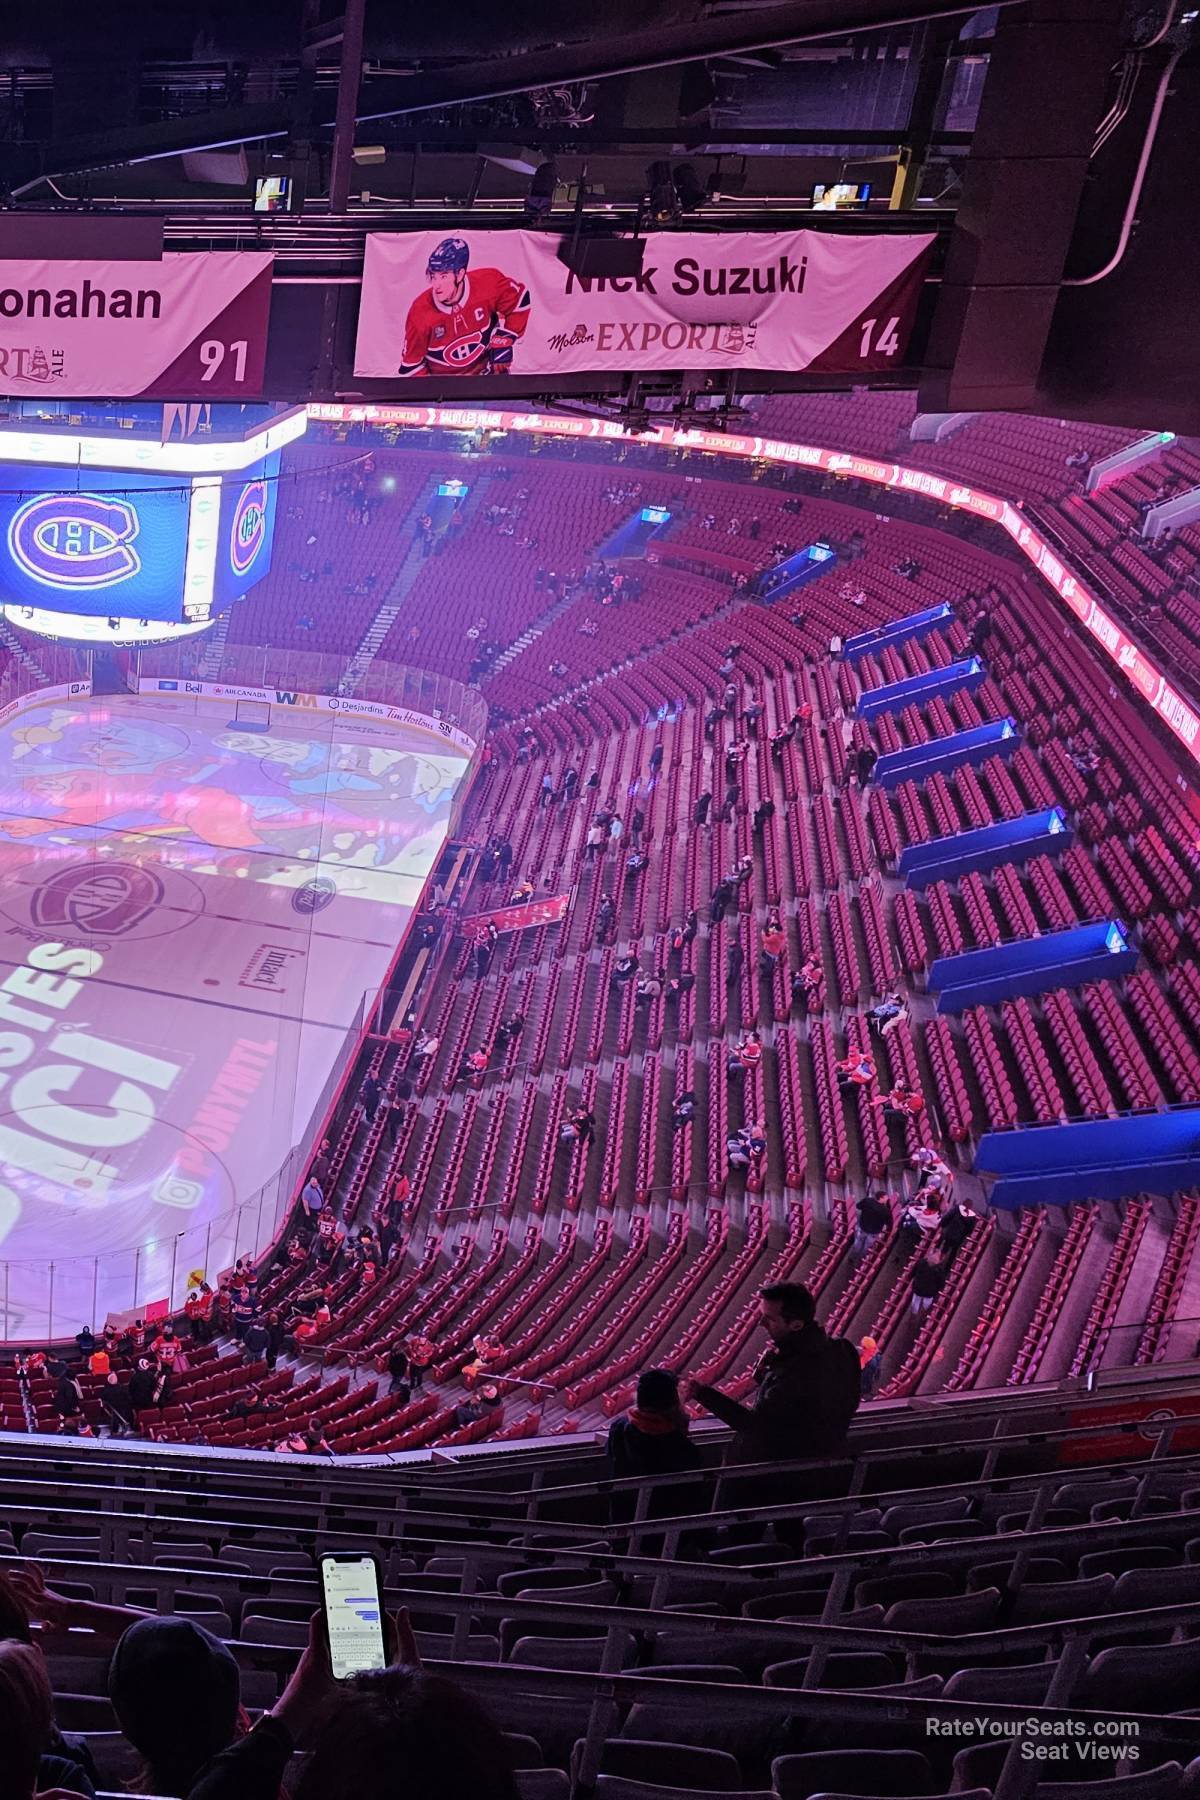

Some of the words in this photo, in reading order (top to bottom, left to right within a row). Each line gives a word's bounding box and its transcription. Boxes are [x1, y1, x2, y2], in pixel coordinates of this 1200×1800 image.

[671, 255, 808, 296] Suzuki
[547, 327, 595, 352] Molson
[596, 321, 726, 355] EXPORT
[746, 322, 757, 349] ALE
[861, 317, 899, 358] 14
[51, 349, 64, 378] ALE
[199, 340, 248, 382] 91
[765, 443, 784, 460] SALUT
[799, 448, 822, 464] VRAIS!
[185, 682, 203, 693] Bell
[237, 689, 267, 698] CANADA
[276, 691, 318, 708] WM
[341, 701, 384, 715] Desjardins
[387, 707, 403, 721] Tim
[403, 711, 434, 731] Hortons
[438, 722, 453, 734] SN
[253, 951, 296, 985] intact
[176, 1038, 279, 1177] PONYMTL
